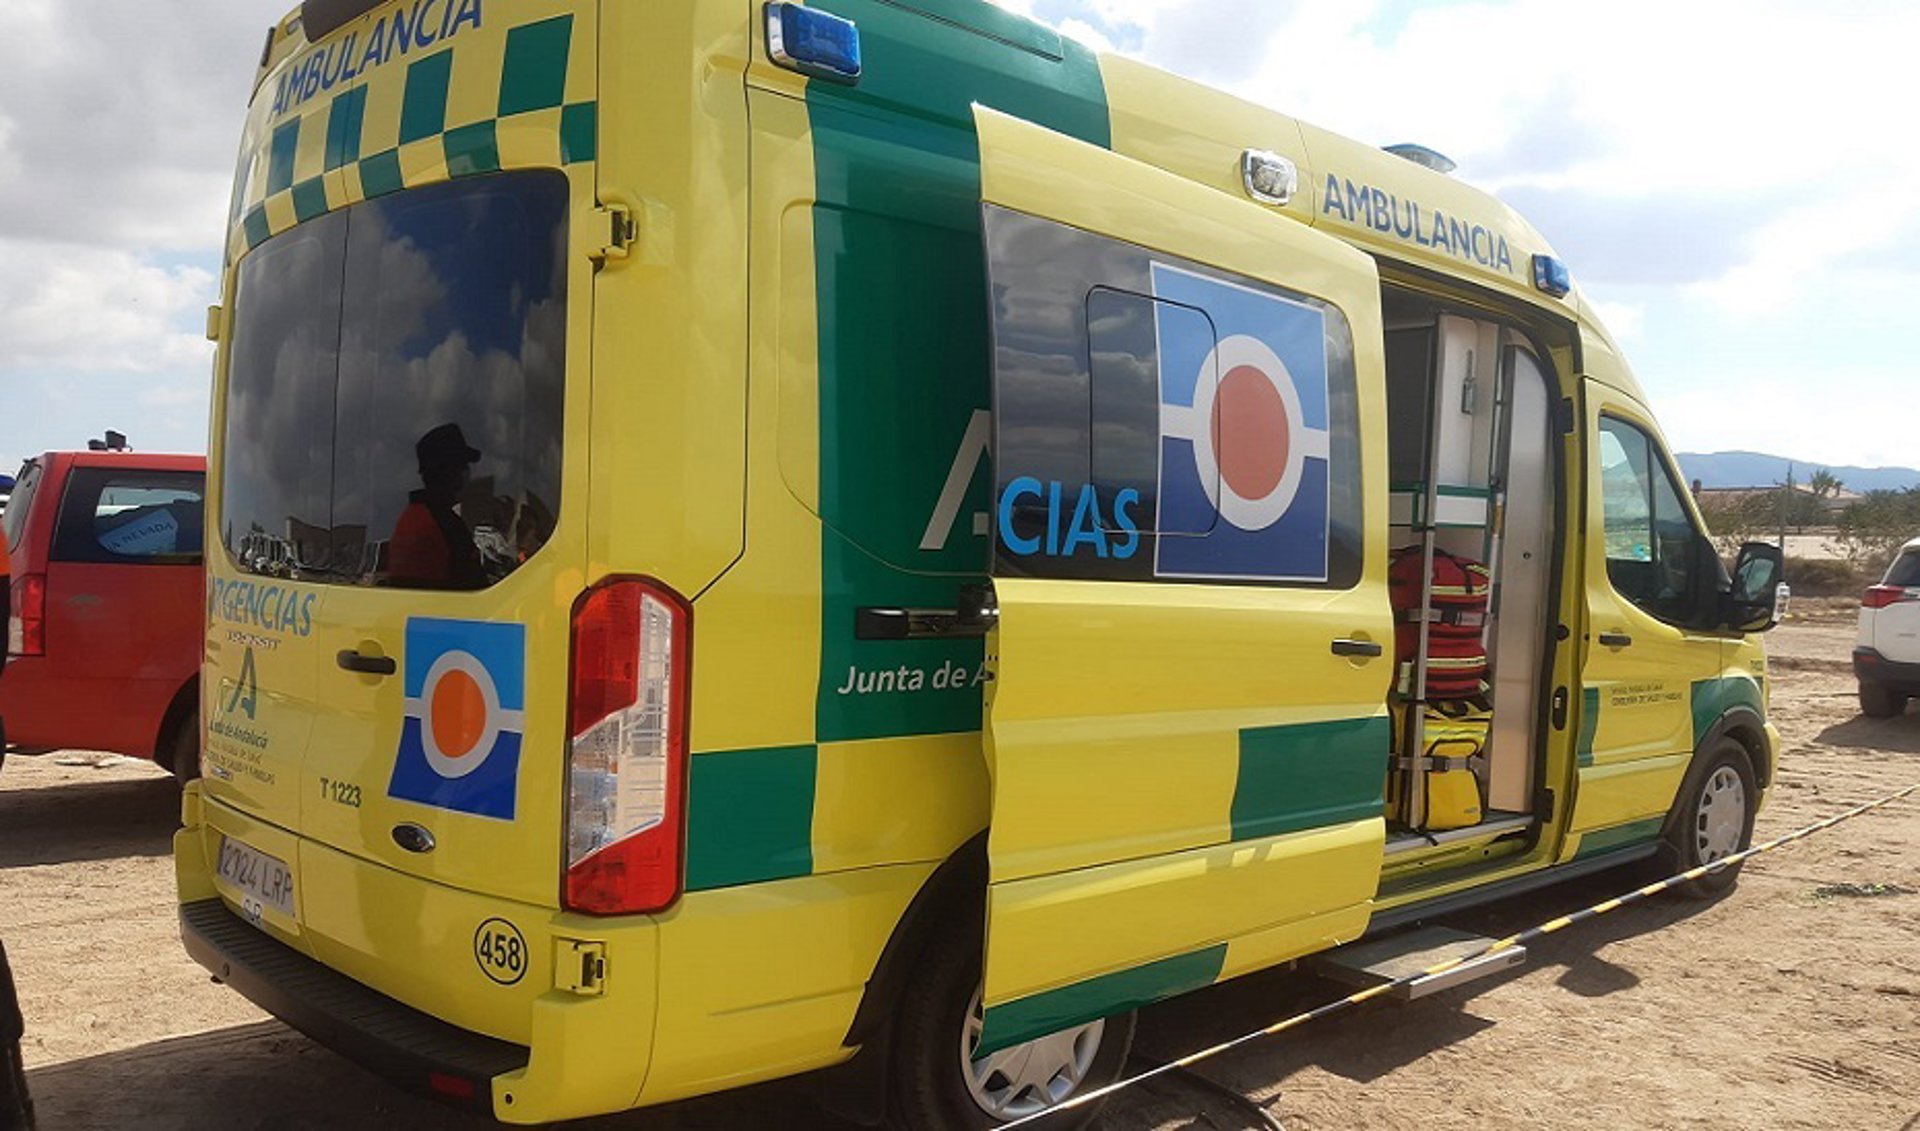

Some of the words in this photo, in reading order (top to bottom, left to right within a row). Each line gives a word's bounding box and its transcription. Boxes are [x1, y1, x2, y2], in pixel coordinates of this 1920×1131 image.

[267, 0, 482, 124] AMBULANCIA
[1323, 173, 1513, 273] AMBULANCIA
[122, 522, 173, 543] NEVADA
[998, 475, 1140, 560] CIAS
[837, 666, 925, 695] Junta
[932, 660, 966, 689] de
[320, 777, 329, 799] T
[330, 780, 362, 808] 1223
[262, 861, 293, 904] LRP
[479, 930, 521, 976] 458
